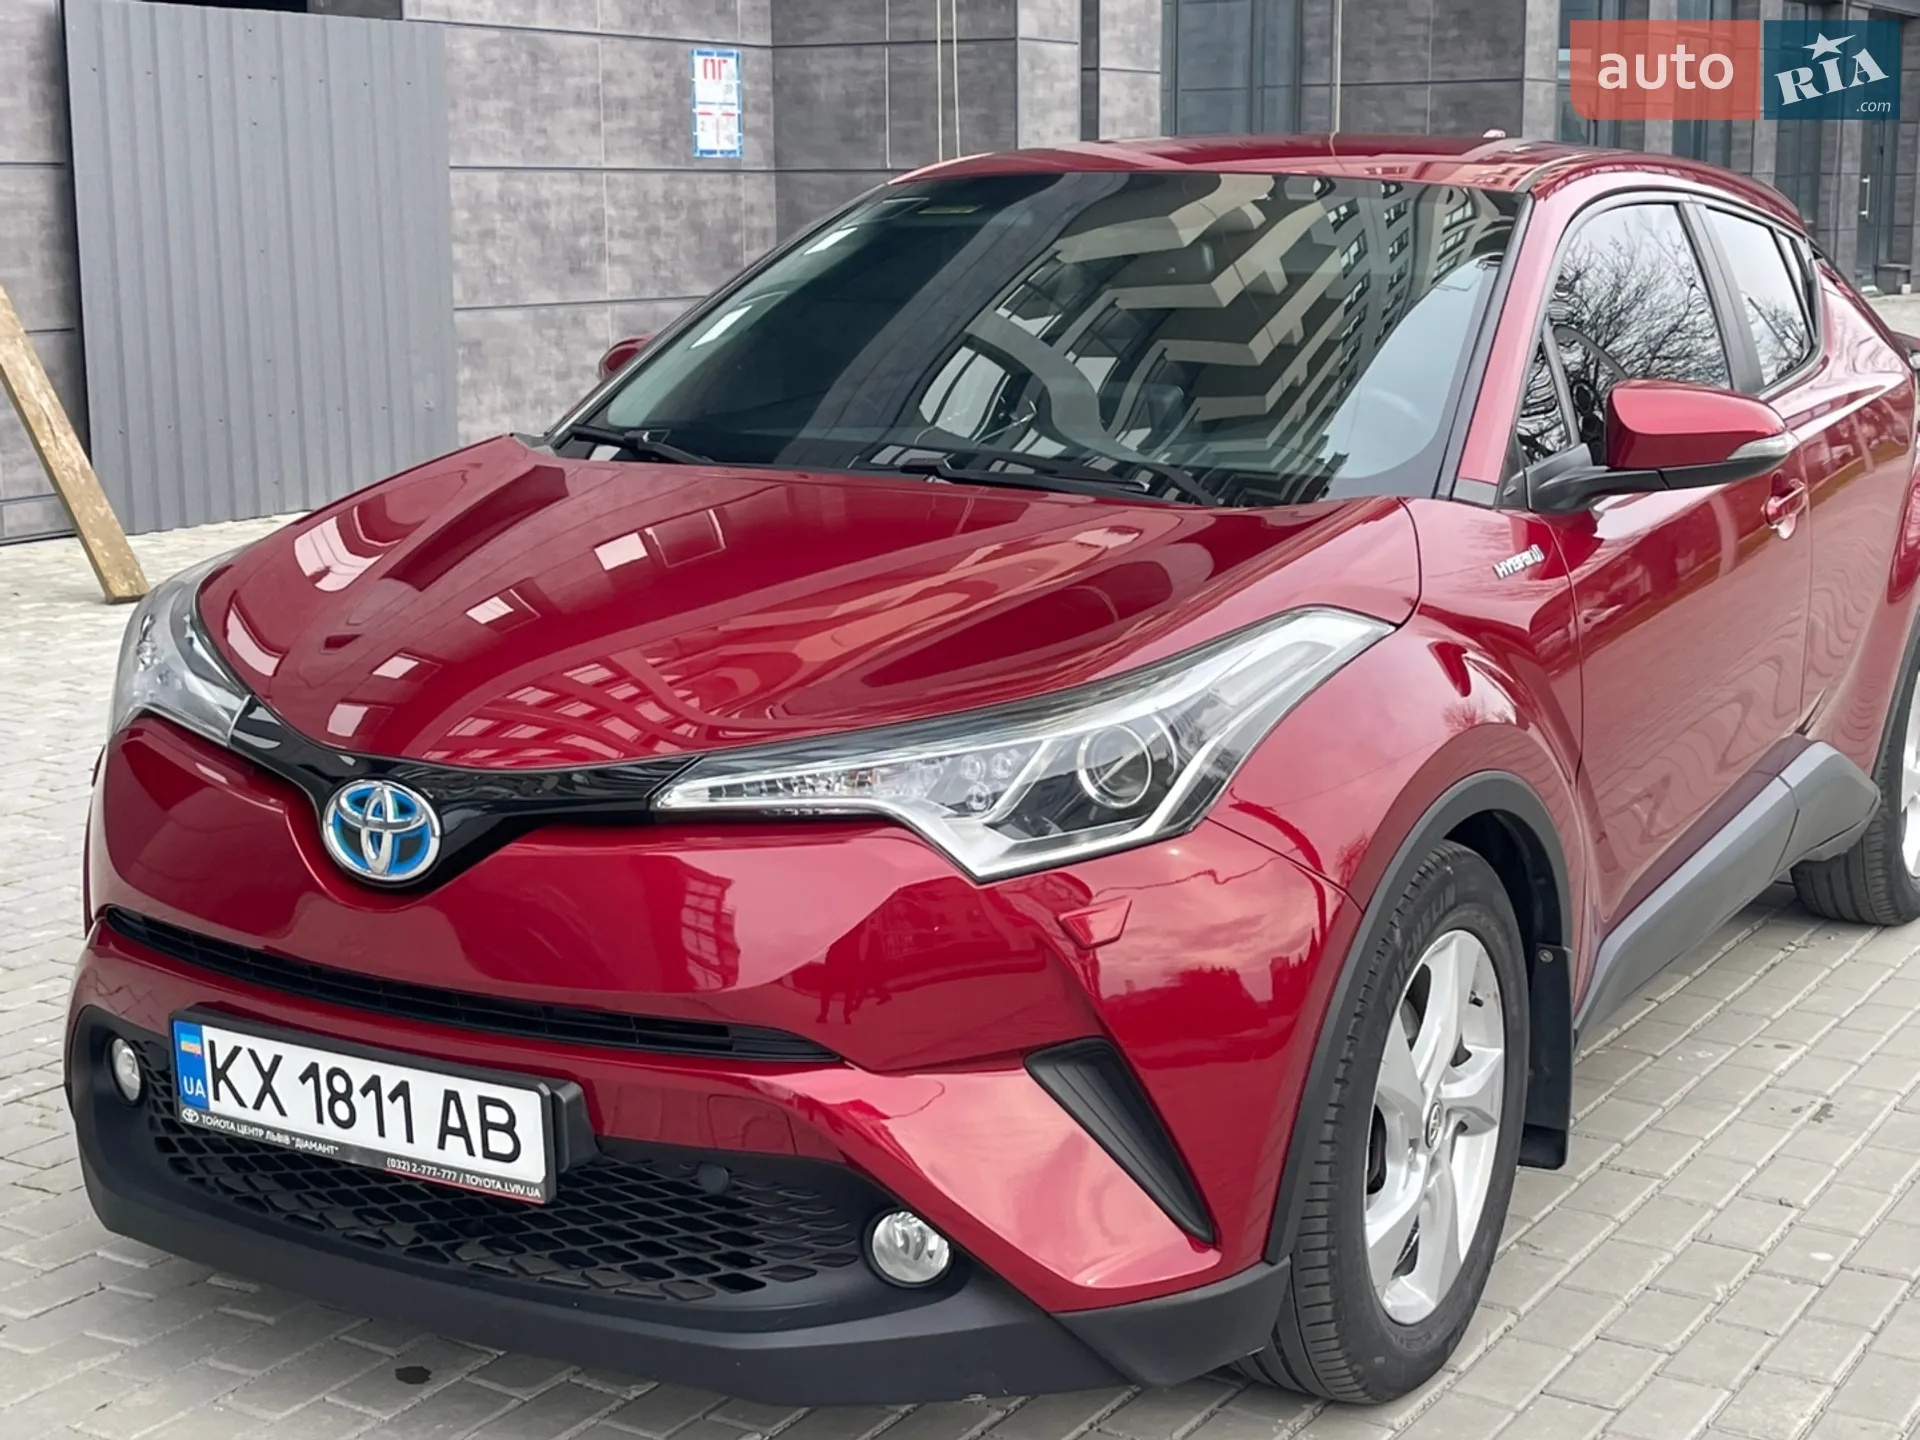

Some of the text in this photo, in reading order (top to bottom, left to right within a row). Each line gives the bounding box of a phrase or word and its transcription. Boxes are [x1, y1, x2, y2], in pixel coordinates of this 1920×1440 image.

[183, 1076, 206, 1098] UA
[208, 1039, 522, 1164] KX 1811 AB
[201, 1113, 339, 1155] ТОЙОТА ЦЕНТР ЛЬВІВ "ДІАМАНТ"
[386, 1156, 411, 1172] (032)
[411, 1163, 458, 1181] 2-777-777
[465, 1174, 541, 1198] TOYOTA.LVIV.UA
